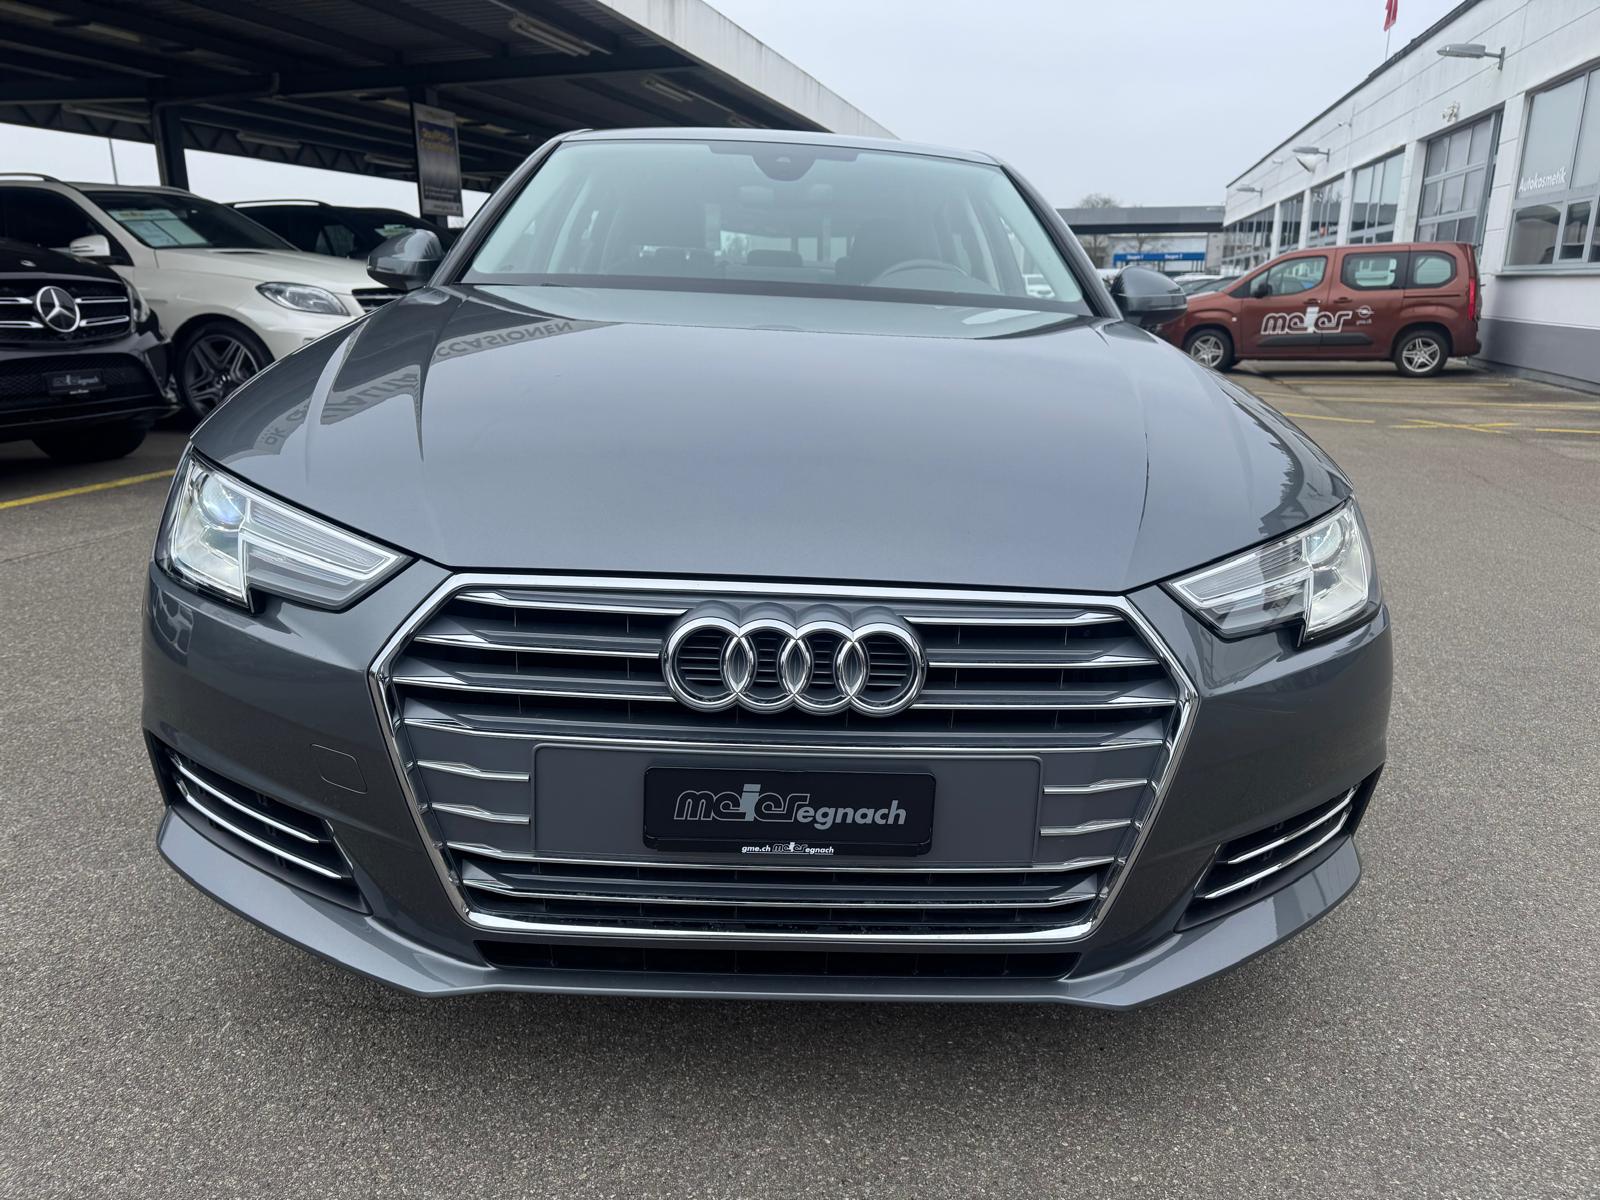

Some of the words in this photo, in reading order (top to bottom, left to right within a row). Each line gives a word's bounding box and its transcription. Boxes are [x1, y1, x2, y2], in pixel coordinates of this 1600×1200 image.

[1518, 166, 1567, 193] Autokosmetik
[796, 800, 908, 831] egnach
[741, 844, 772, 854] gme.ch
[804, 846, 835, 856] egnach
